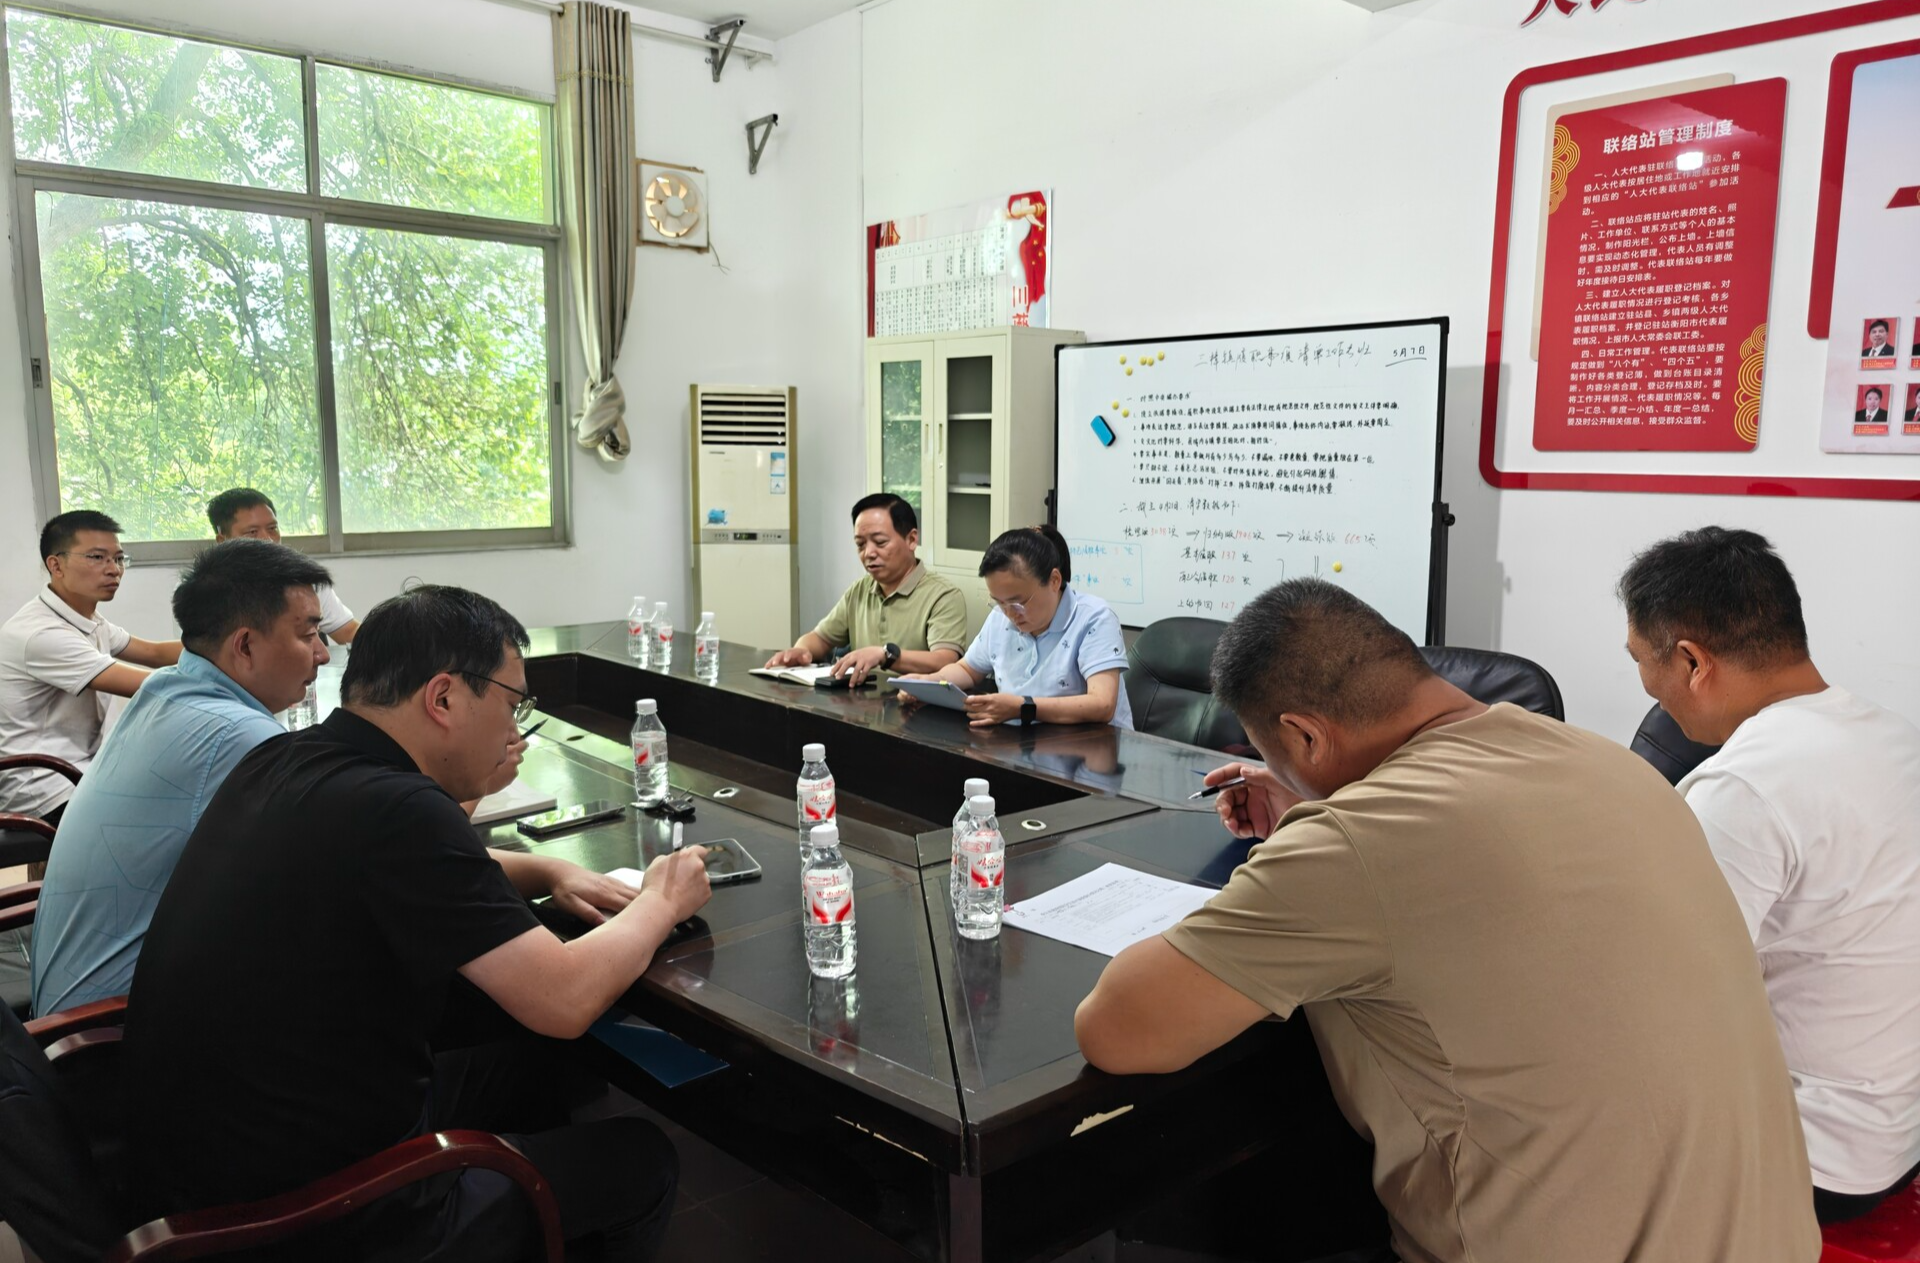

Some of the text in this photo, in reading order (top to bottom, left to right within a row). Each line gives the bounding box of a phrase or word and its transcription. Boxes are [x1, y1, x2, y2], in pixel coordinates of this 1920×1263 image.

[1603, 119, 1734, 154] 联络站管理制度
